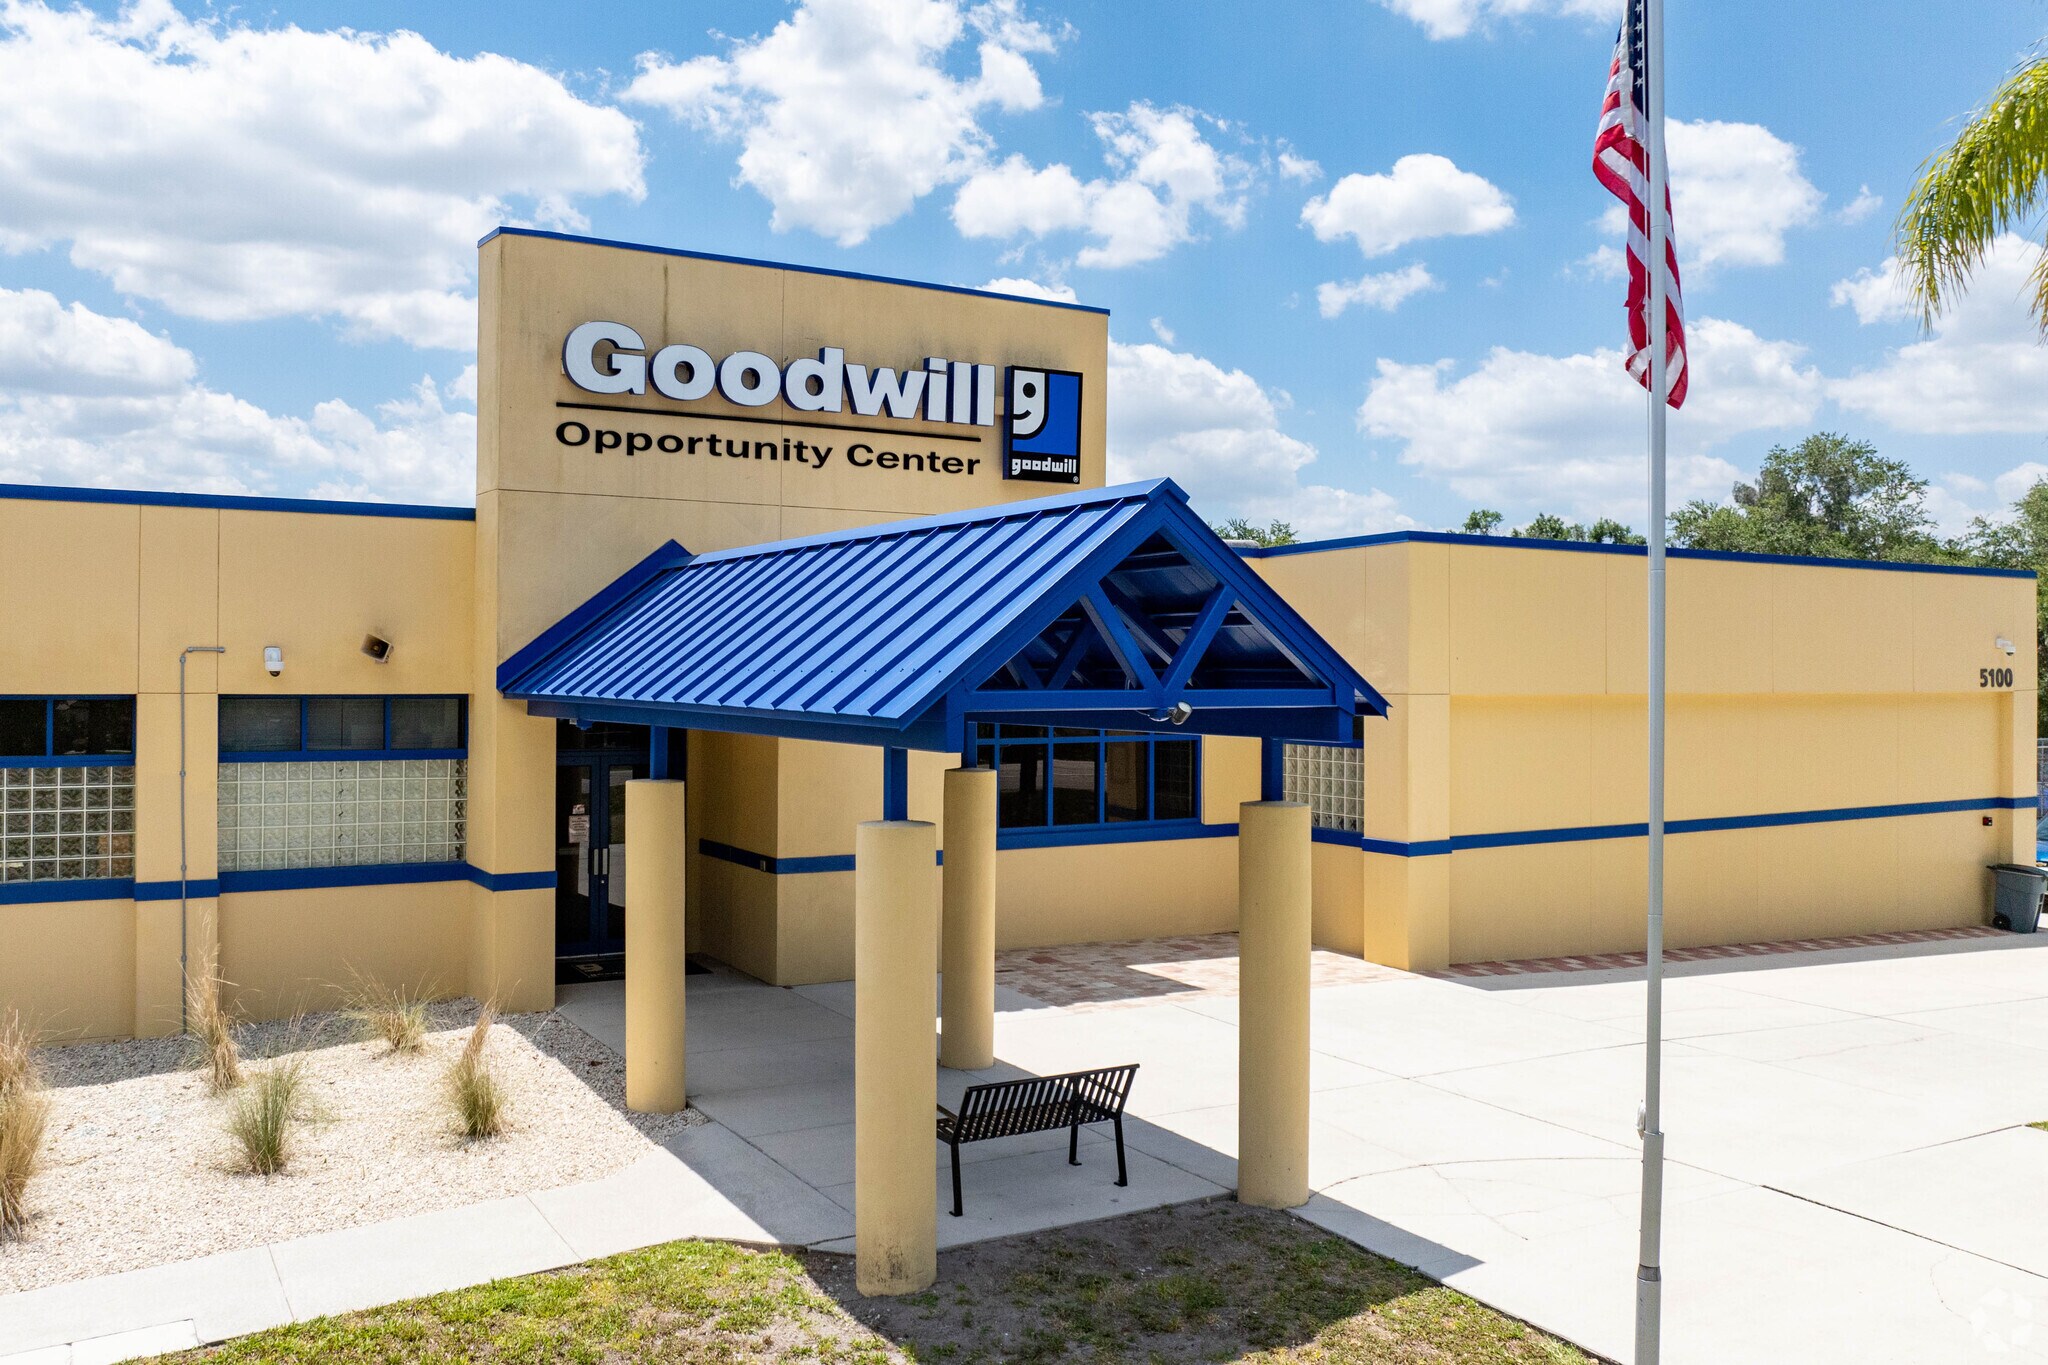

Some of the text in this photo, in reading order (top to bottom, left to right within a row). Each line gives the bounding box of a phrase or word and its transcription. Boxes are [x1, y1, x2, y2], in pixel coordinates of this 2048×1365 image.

[563, 321, 995, 426] Goodwill
[556, 421, 981, 475] Opportunity Center
[1011, 457, 1077, 475] goodwill
[1979, 668, 2013, 688] 5100
